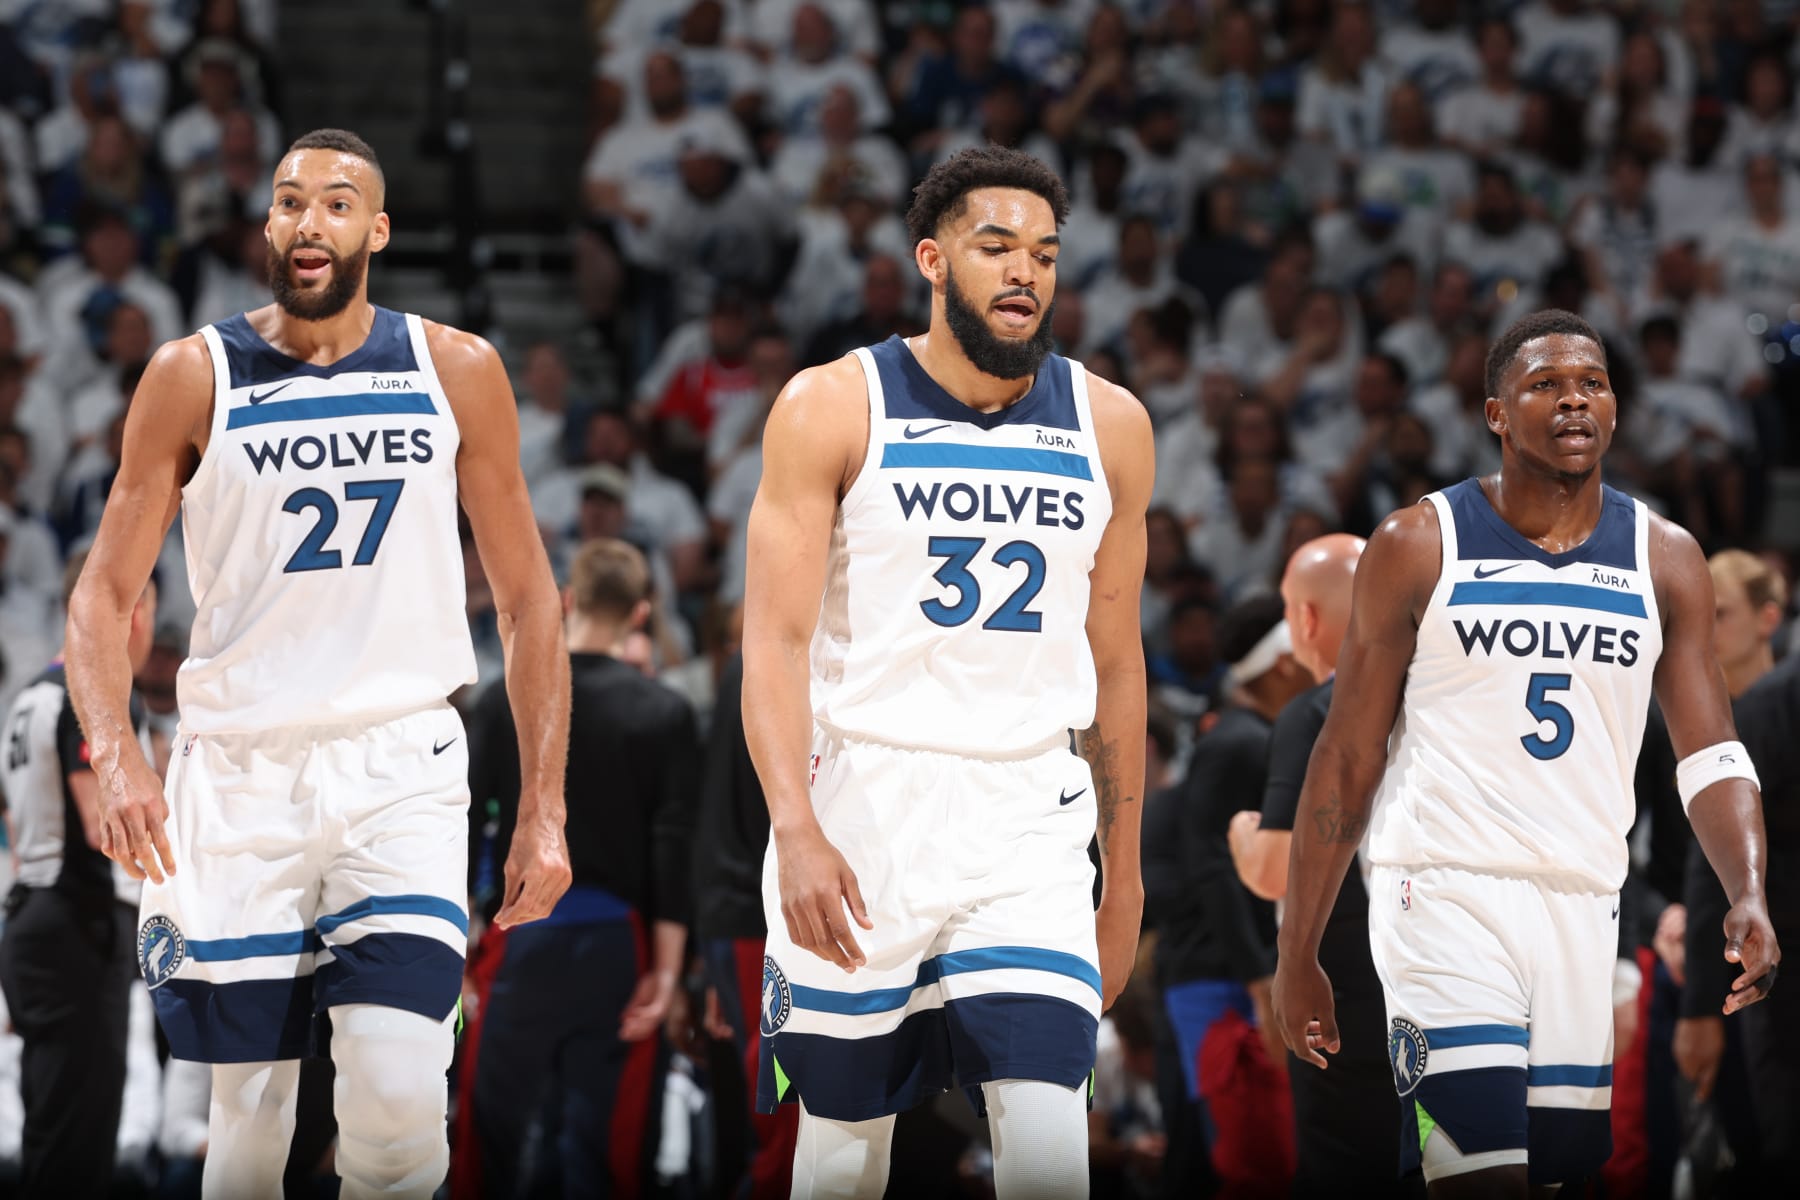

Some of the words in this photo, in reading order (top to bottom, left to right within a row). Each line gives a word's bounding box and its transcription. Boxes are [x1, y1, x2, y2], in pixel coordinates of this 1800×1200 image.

[242, 428, 434, 476] WOLVES
[281, 478, 405, 573] 27
[892, 482, 1085, 531] WOLVES
[919, 536, 1047, 633] 32
[1452, 619, 1641, 668] WOLVES
[1520, 672, 1575, 761] 5
[1719, 754, 1736, 765] 5
[767, 957, 790, 1027] TIMBERWOLVES
[1394, 1018, 1427, 1077] TIMBERWOLVES
